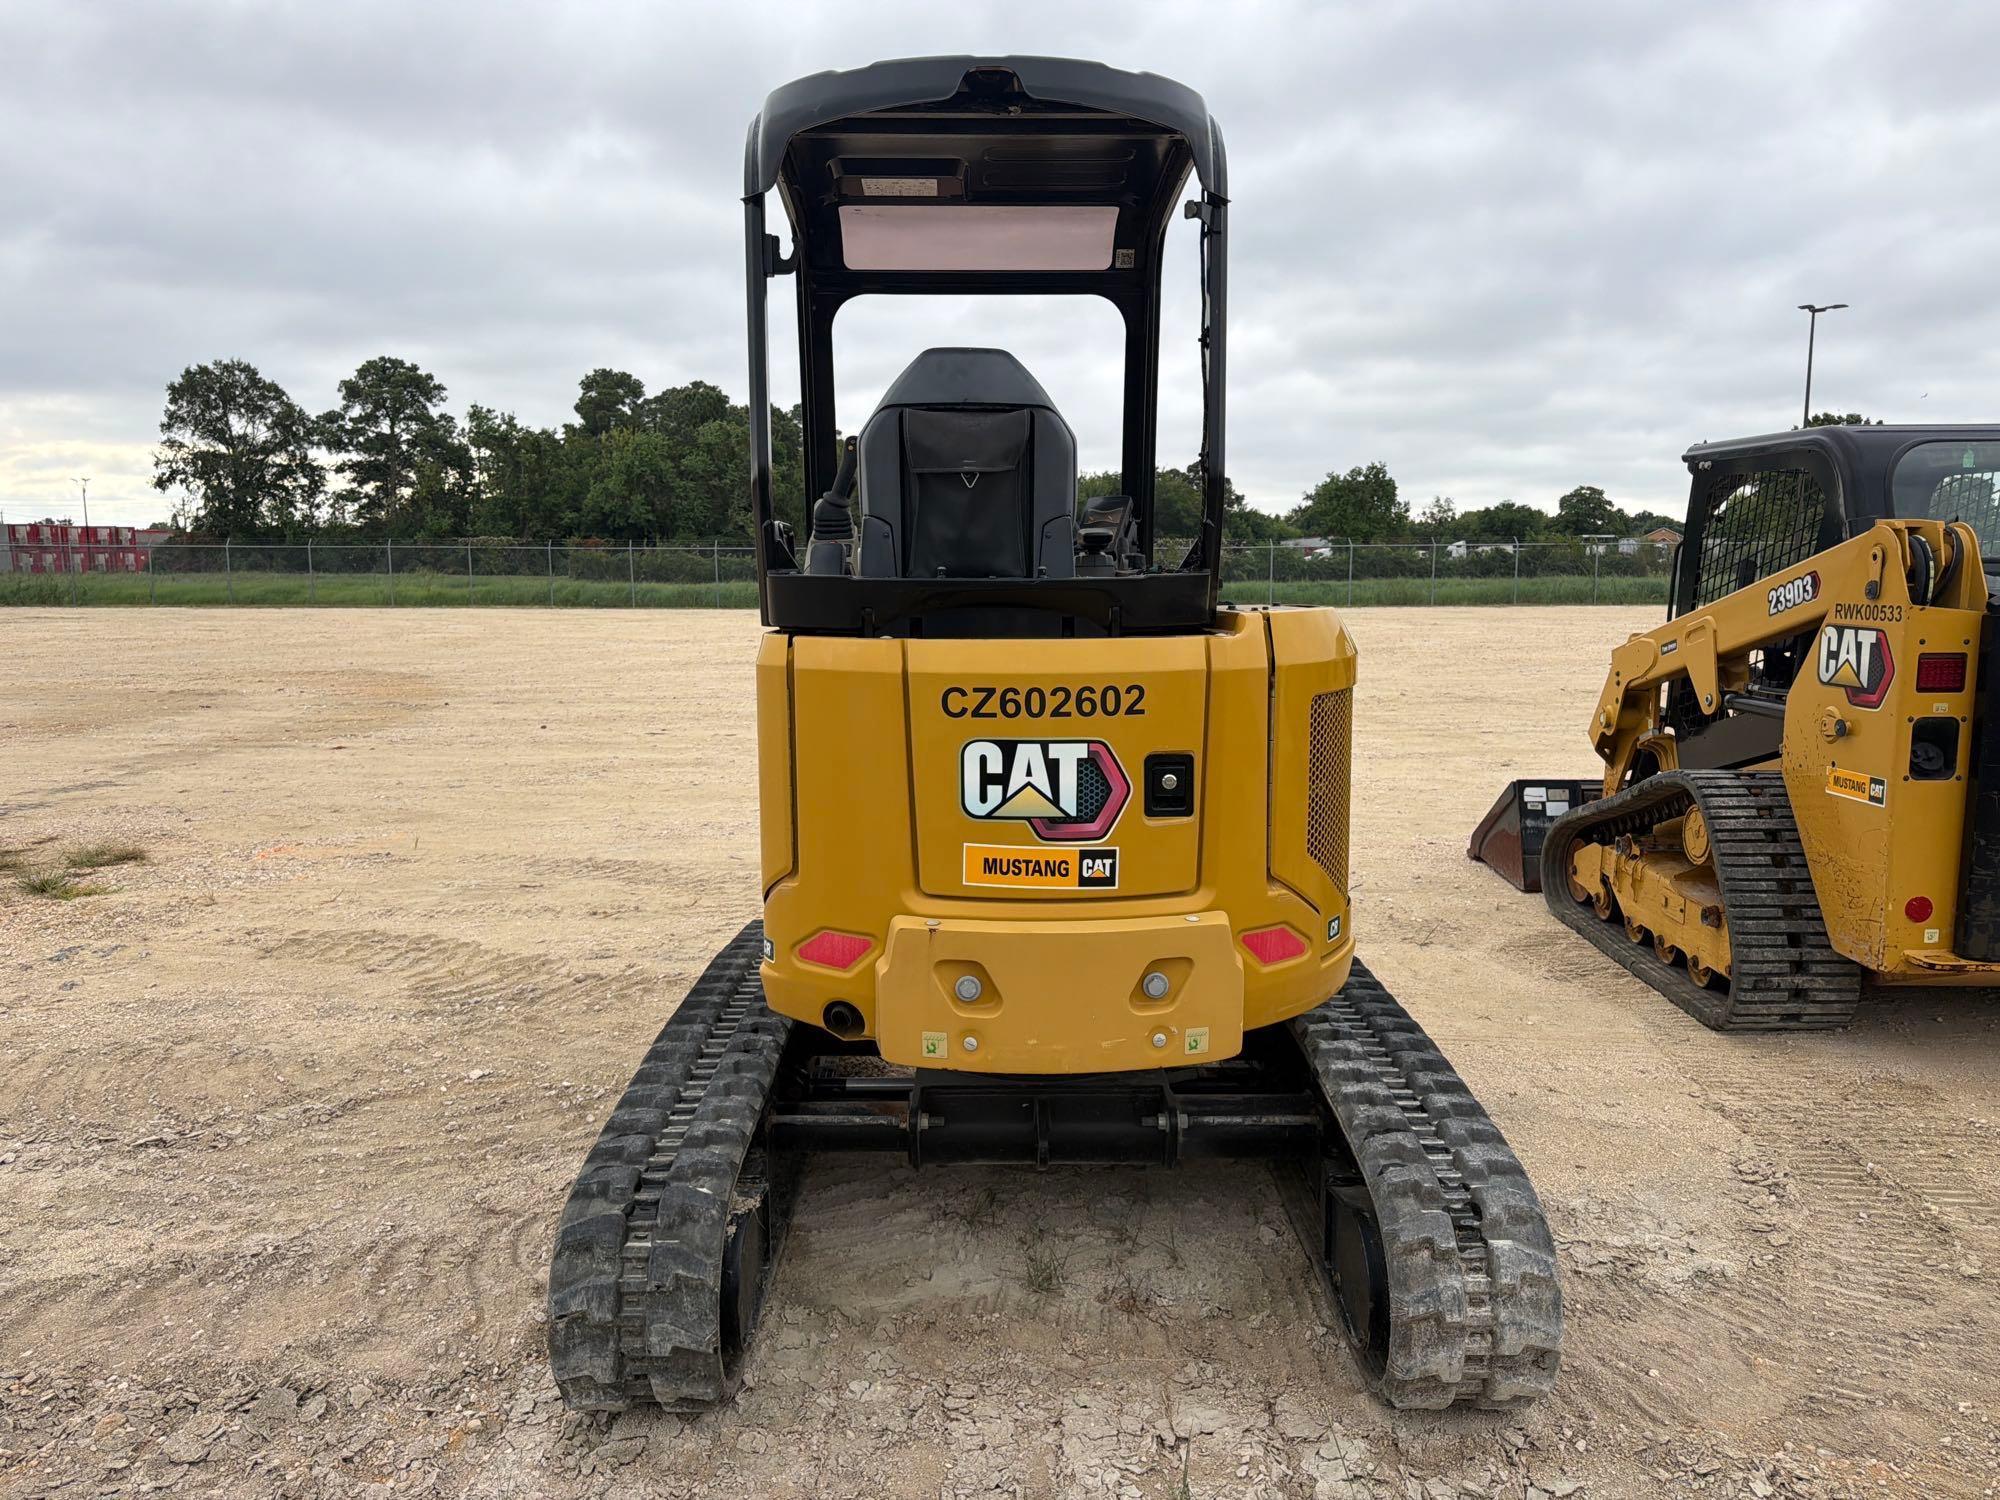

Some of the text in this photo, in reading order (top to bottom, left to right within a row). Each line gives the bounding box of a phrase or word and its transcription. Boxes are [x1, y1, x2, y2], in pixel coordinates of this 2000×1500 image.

[1768, 574, 1813, 616] 239D3
[1834, 603, 1903, 622] RWK00533
[1820, 626, 1877, 689] CAT
[941, 684, 1146, 719] CZ602602
[963, 741, 1089, 817] CAT
[1832, 775, 1884, 798] MUSTANG CAT
[982, 857, 1113, 878] MUSTANG CAT
